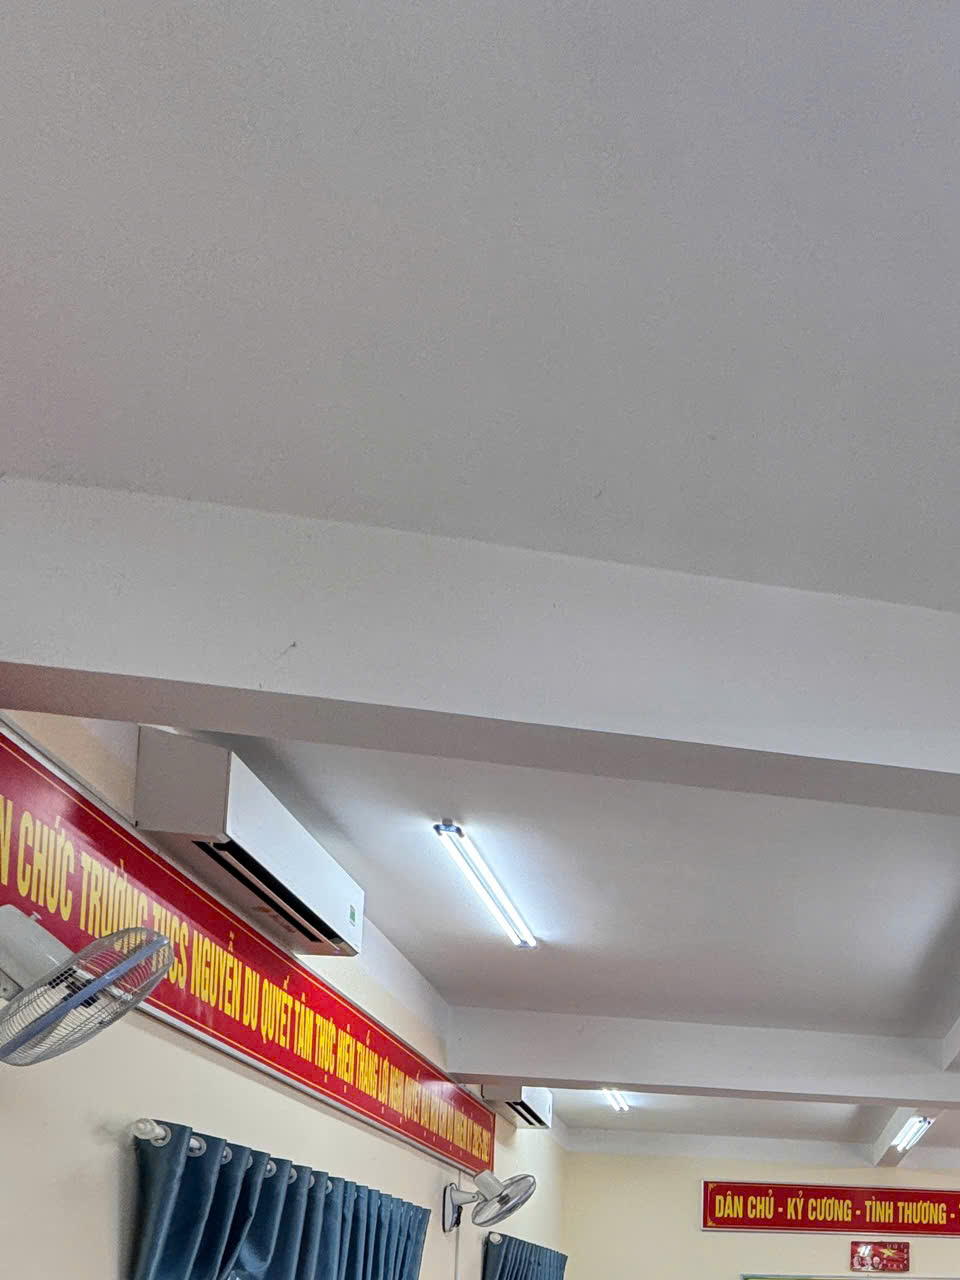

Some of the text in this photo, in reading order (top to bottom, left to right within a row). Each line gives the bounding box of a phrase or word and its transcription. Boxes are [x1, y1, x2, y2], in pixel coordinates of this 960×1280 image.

[17, 811, 75, 921] CHỨC
[190, 929, 243, 1022] NGUYỄN
[243, 965, 260, 1031] DU
[260, 975, 294, 1050] QUYẾT
[293, 991, 315, 1063] TÂM
[314, 1012, 337, 1084] THỰC
[715, 1190, 744, 1218] DÂN
[747, 1189, 775, 1220] CHỦ
[786, 1190, 804, 1220] KỶ
[808, 1196, 852, 1222] CƯƠNG
[864, 1195, 894, 1223] TÌNH
[897, 1200, 947, 1225] THƯƠNG
